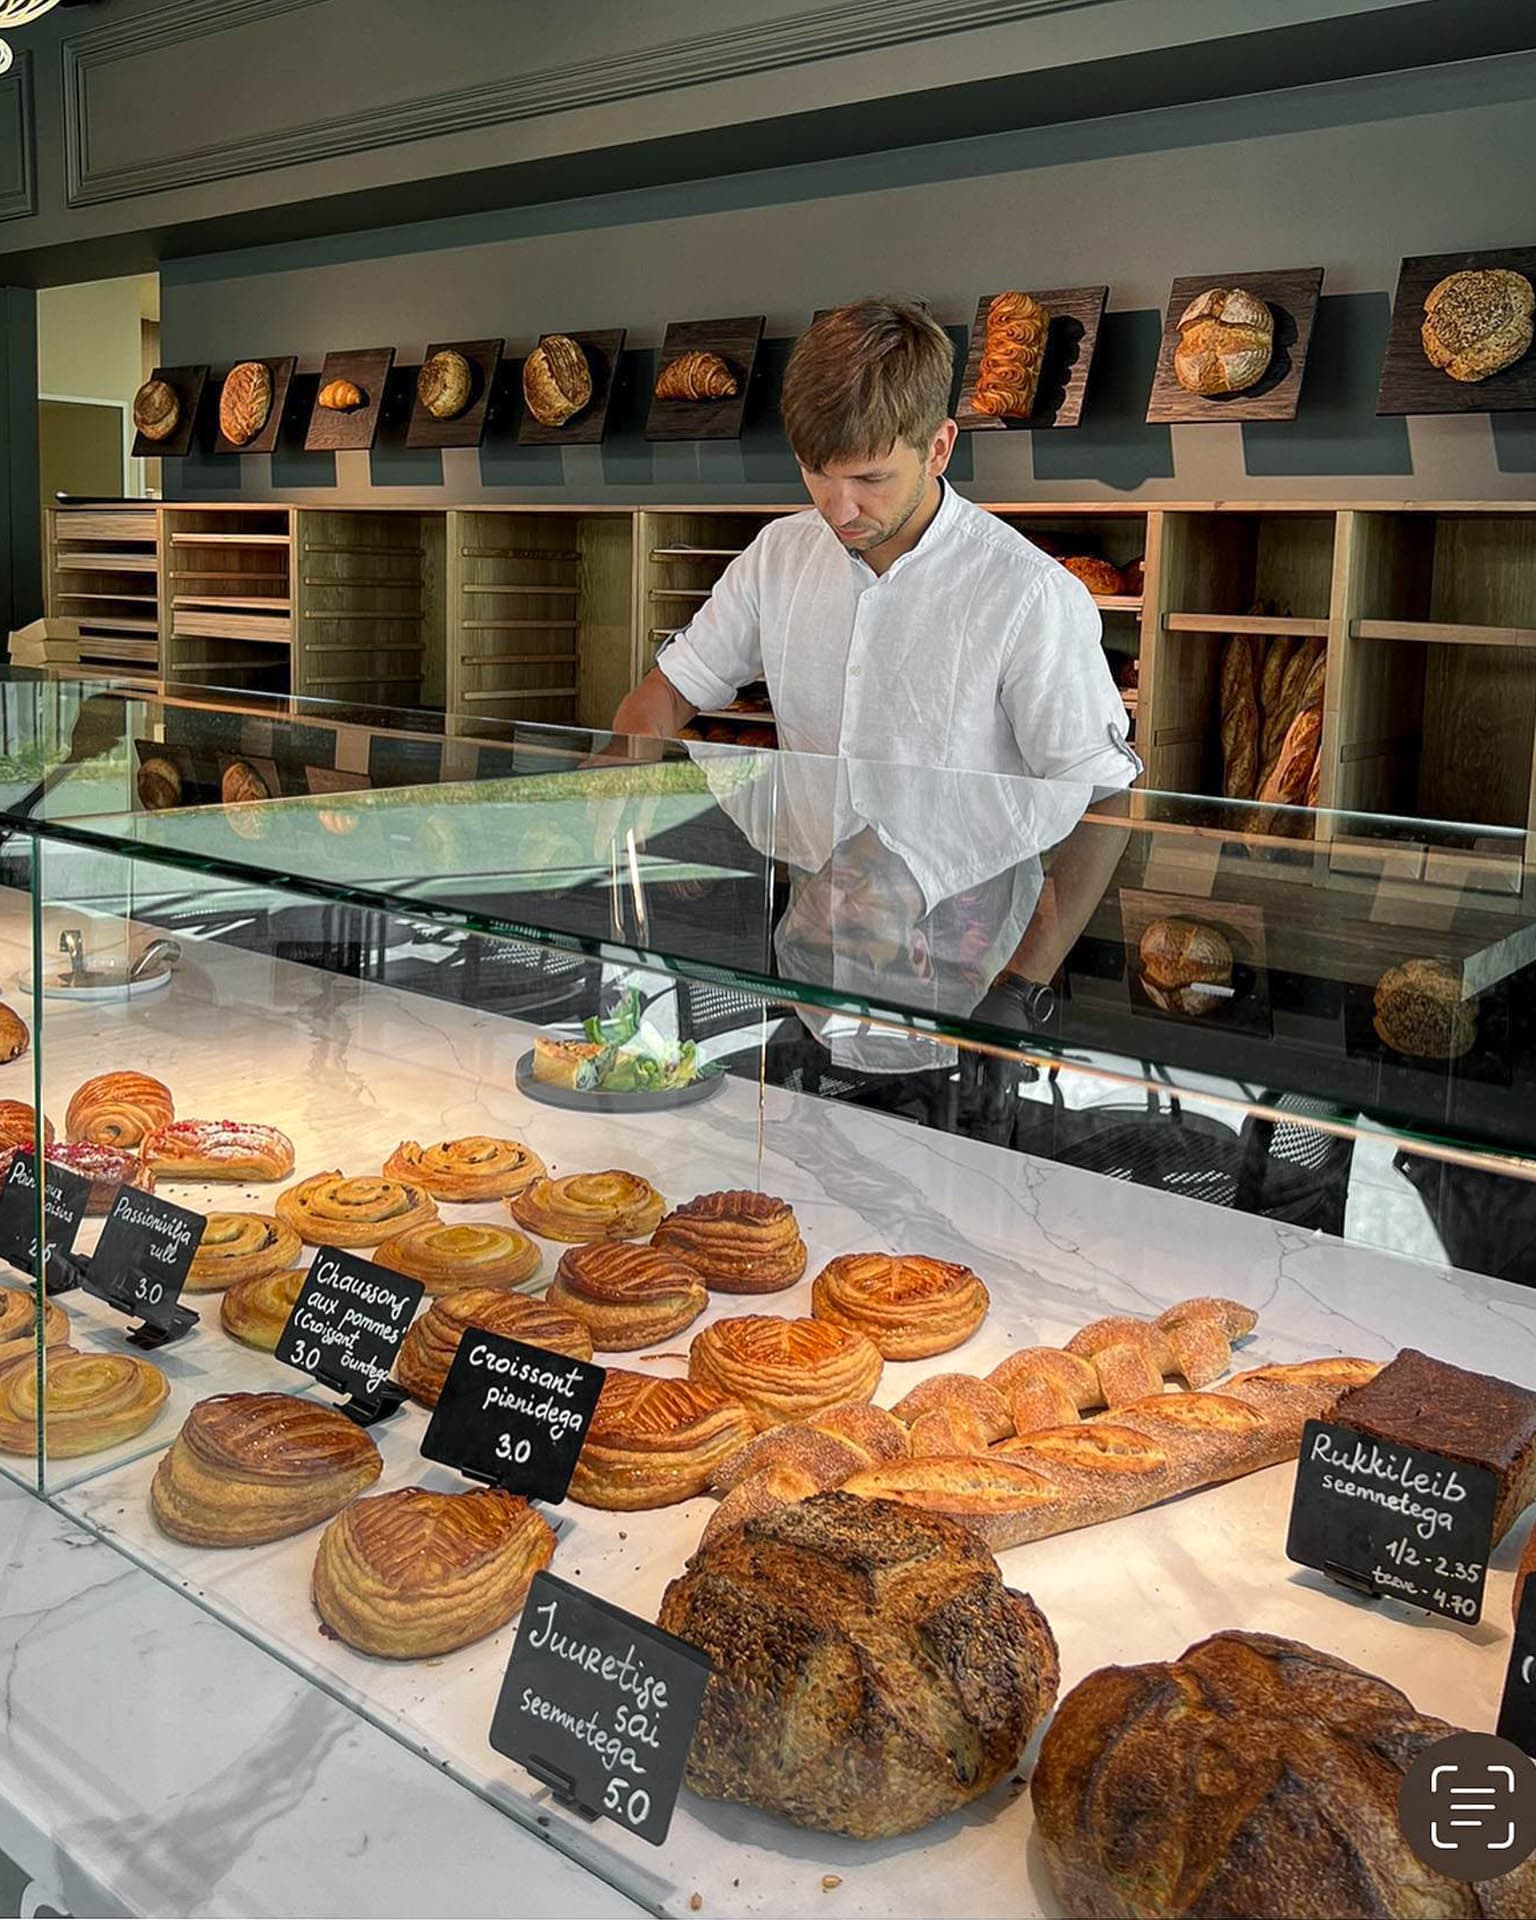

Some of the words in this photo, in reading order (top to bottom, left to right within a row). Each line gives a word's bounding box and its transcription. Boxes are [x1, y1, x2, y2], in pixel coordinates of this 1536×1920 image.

[135, 1277, 163, 1305] 3.0
[307, 1291, 340, 1315] aux
[294, 1308, 361, 1350] (Croissant
[290, 1340, 321, 1370] 3.0
[469, 1344, 584, 1397] Croissant
[495, 1433, 532, 1463] 3.0
[1310, 1433, 1467, 1502] Rukkileib
[1322, 1474, 1454, 1540] seemnetega
[1434, 1557, 1482, 1583] 2.35
[1433, 1588, 1477, 1617] 4.70
[528, 1601, 669, 1710] Juuretise
[520, 1687, 647, 1773] seemnetega
[614, 1705, 660, 1748] sai
[603, 1777, 650, 1825] 5.0
